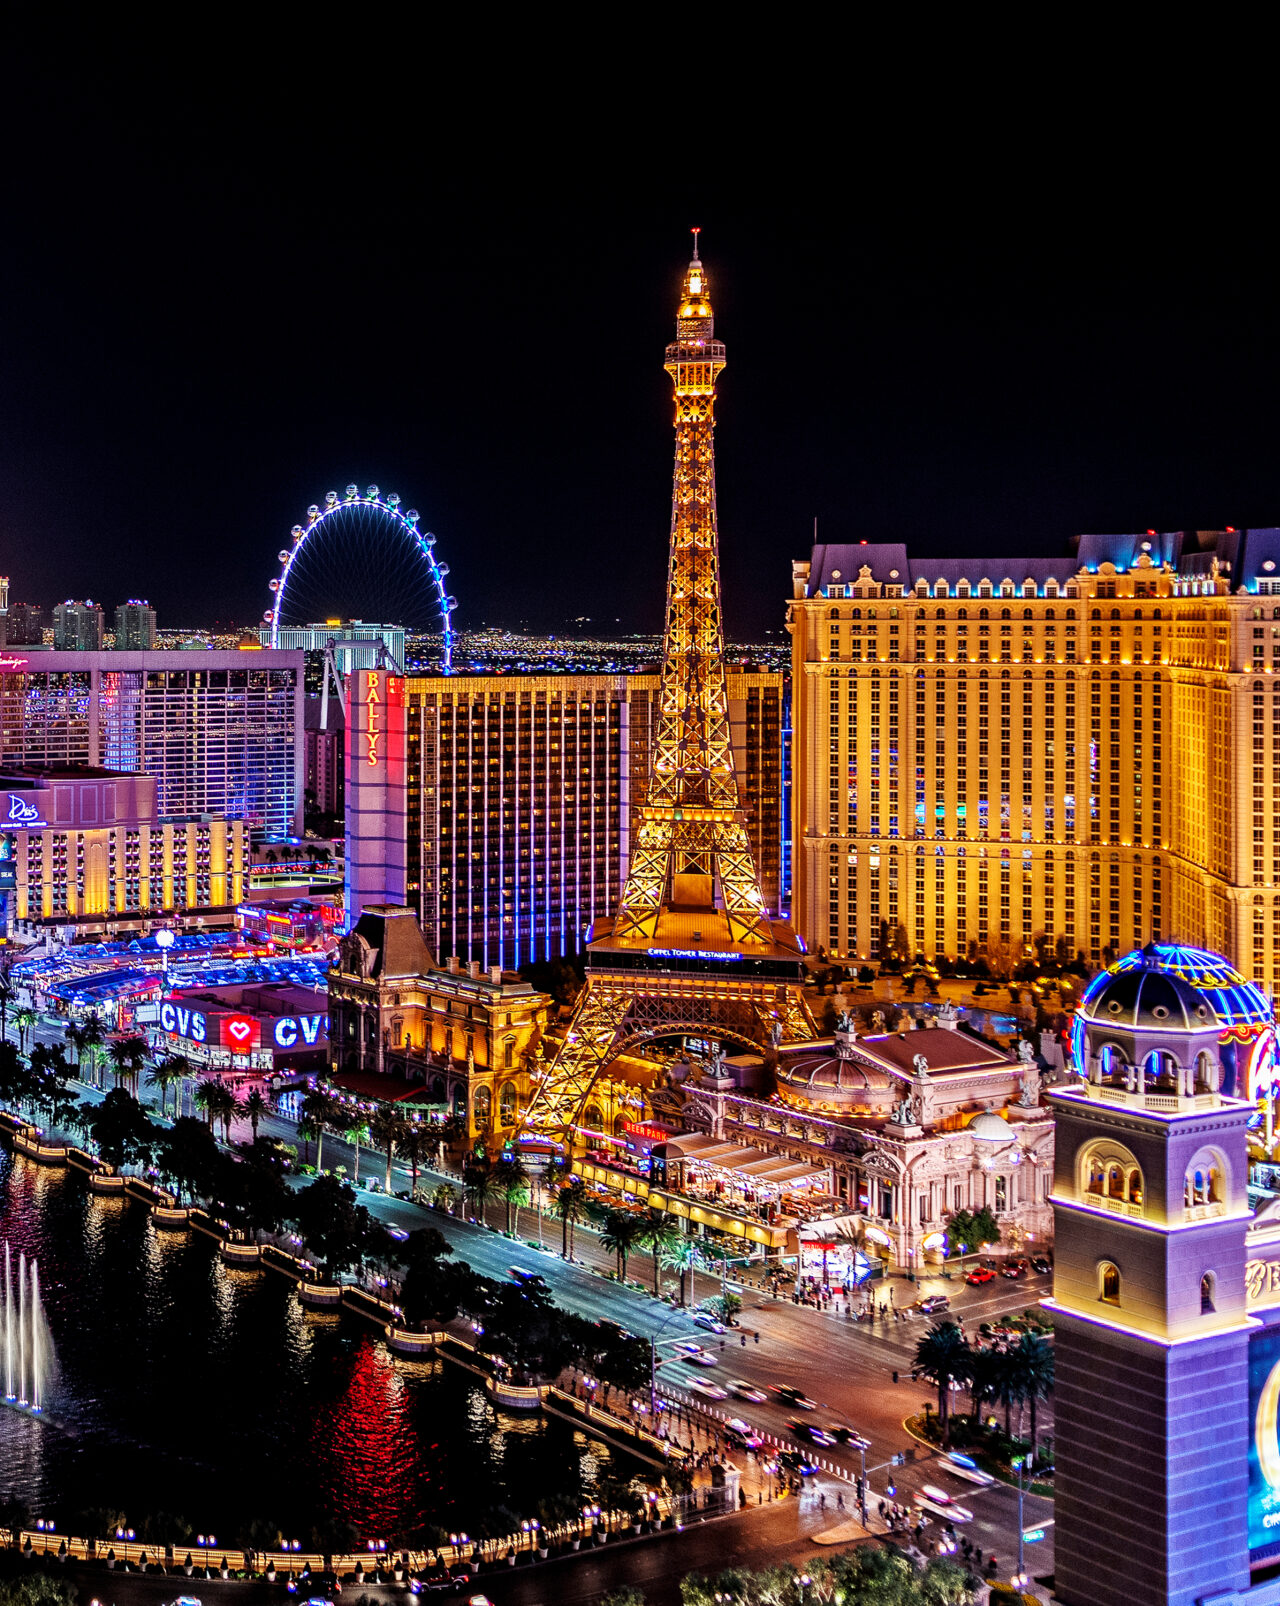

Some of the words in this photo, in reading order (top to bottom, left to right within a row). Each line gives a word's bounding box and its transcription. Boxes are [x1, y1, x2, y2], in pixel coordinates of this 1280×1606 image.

[647, 948, 671, 956] EIFFEL
[672, 949, 696, 957] TOWER
[698, 950, 740, 959] RESTAURANT
[160, 1002, 207, 1042] CVS
[626, 1122, 646, 1136] BEER
[646, 1128, 667, 1141] PARK
